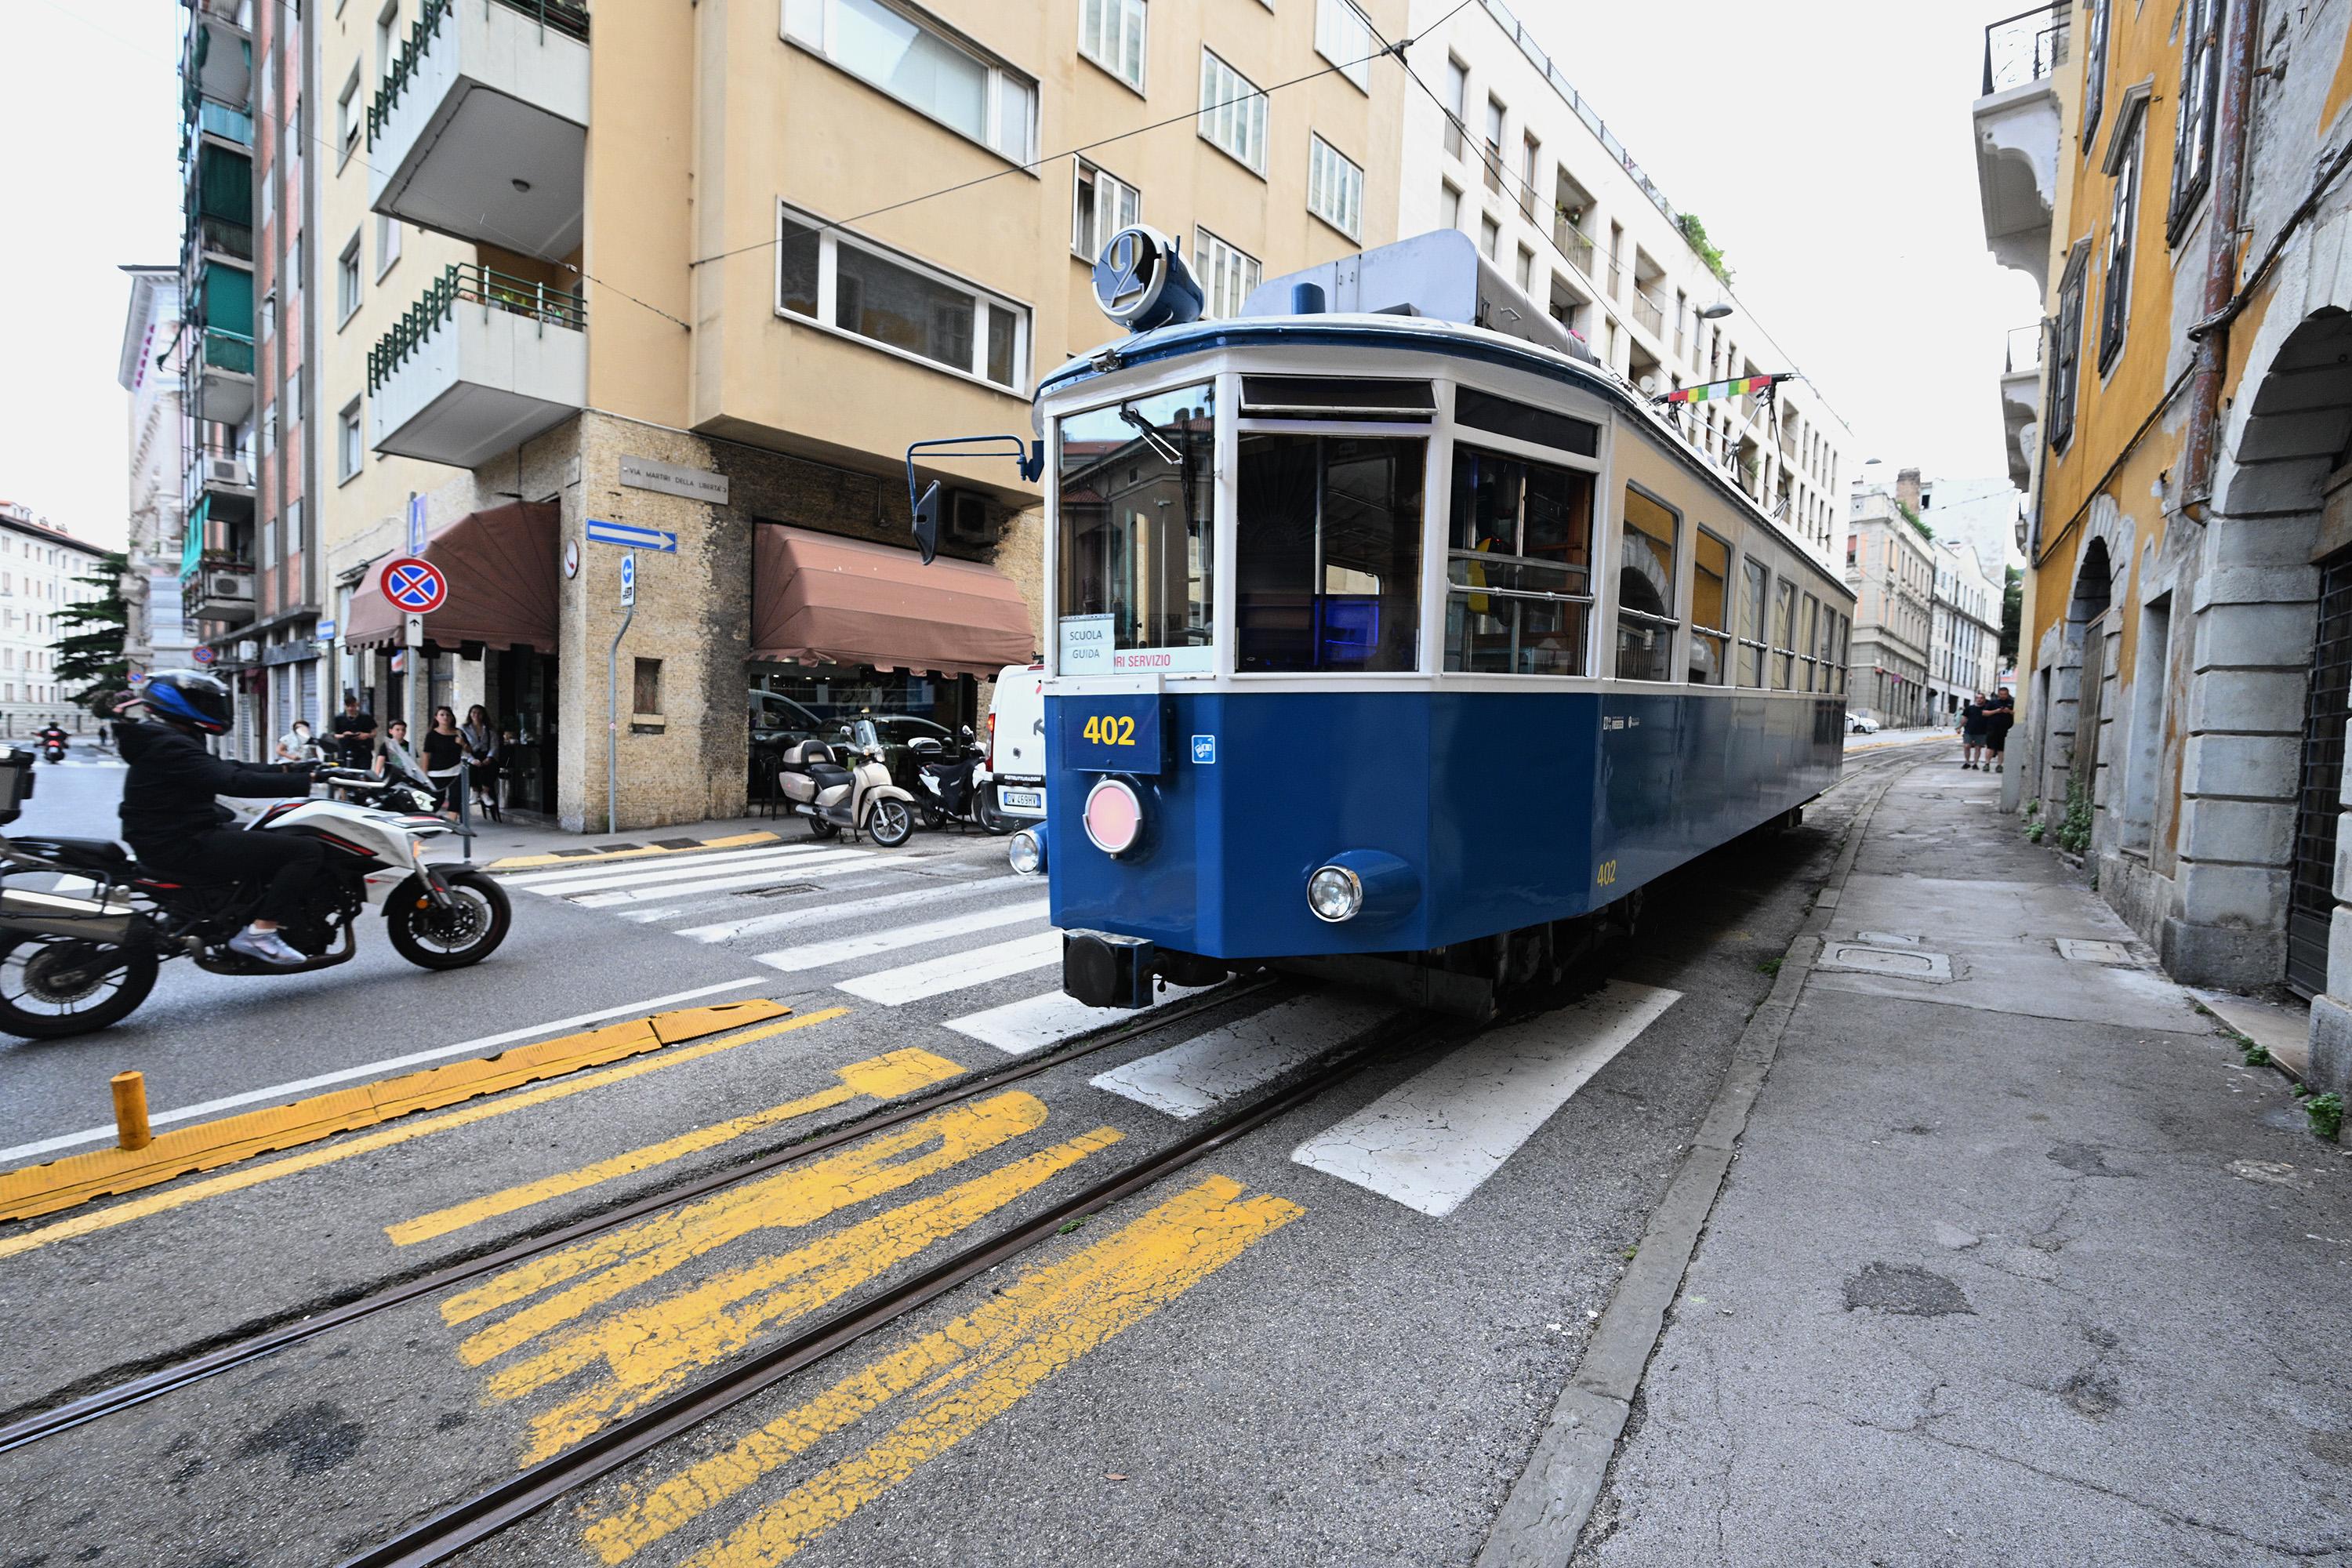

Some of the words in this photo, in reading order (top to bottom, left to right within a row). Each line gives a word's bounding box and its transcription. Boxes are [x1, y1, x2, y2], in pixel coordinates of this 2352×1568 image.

[1108, 230, 1145, 310] 2
[630, 467, 641, 476] VIA
[646, 471, 670, 482] MARTIRI
[675, 477, 694, 486] DELLA
[1069, 630, 1103, 641] SCUOLA
[1073, 649, 1100, 659] GUIDA
[1128, 654, 1171, 667] SERVIZIO
[1083, 715, 1135, 746] 402
[1597, 859, 1617, 887] 402
